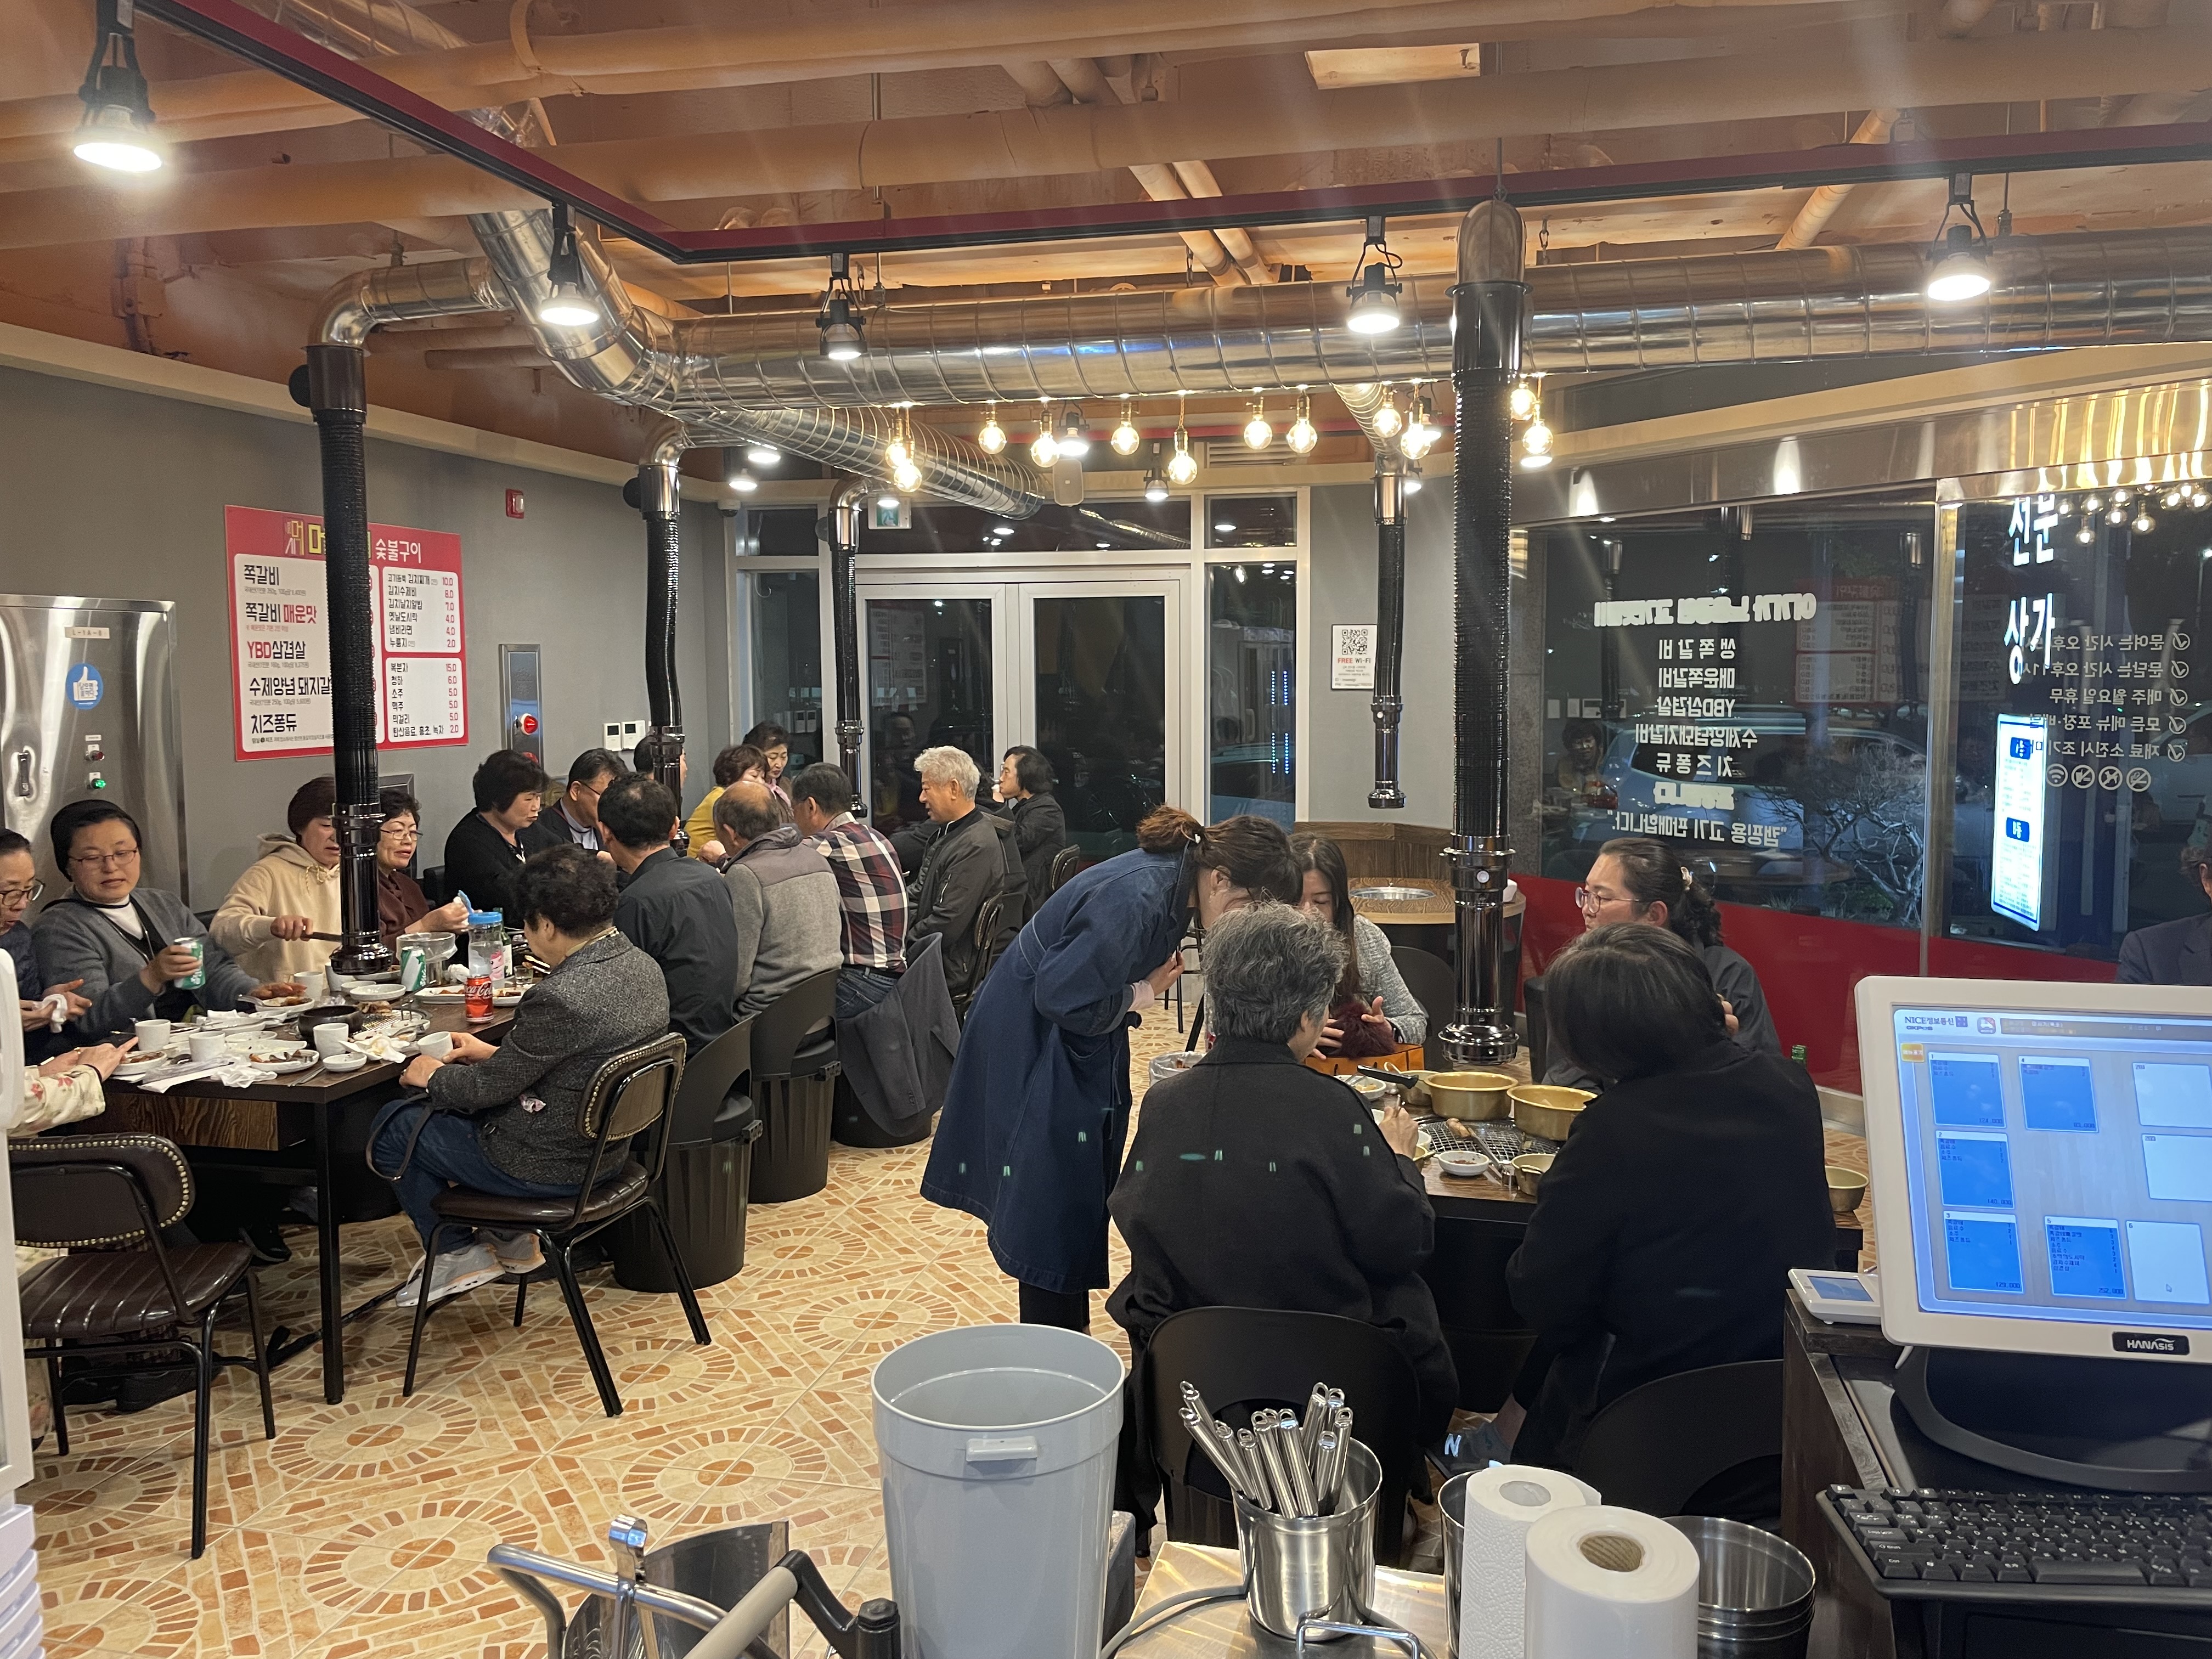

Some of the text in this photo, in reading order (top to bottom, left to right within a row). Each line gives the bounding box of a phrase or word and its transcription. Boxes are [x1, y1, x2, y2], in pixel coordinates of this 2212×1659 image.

[375, 538, 421, 563] 숯불구이
[244, 565, 279, 585] 쪽갈비
[442, 577, 453, 586] 10.0
[388, 585, 453, 598] 김치수제비 8.0
[445, 602, 454, 611] 7.0
[246, 602, 317, 624] 쪽갈비 매운맛
[389, 612, 454, 623] 옛날도시락 4.0
[389, 625, 455, 635] 냄비라면 4.0
[447, 639, 455, 647] 2.0
[2004, 593, 2056, 685] 상가
[247, 641, 306, 659] YBD삼겹살
[391, 663, 456, 673] 복분자 15.0
[391, 675, 457, 686] 청하 6.0
[250, 677, 331, 696] 수제양념 돼지갈
[392, 688, 458, 698] 소주 5.0
[392, 701, 458, 711] 맥주 5.0
[251, 714, 297, 733] 치즈퐁듀
[393, 713, 458, 724] 막걸리 5.0
[450, 725, 459, 733] 2.0
[1444, 1433, 1462, 1457] N
